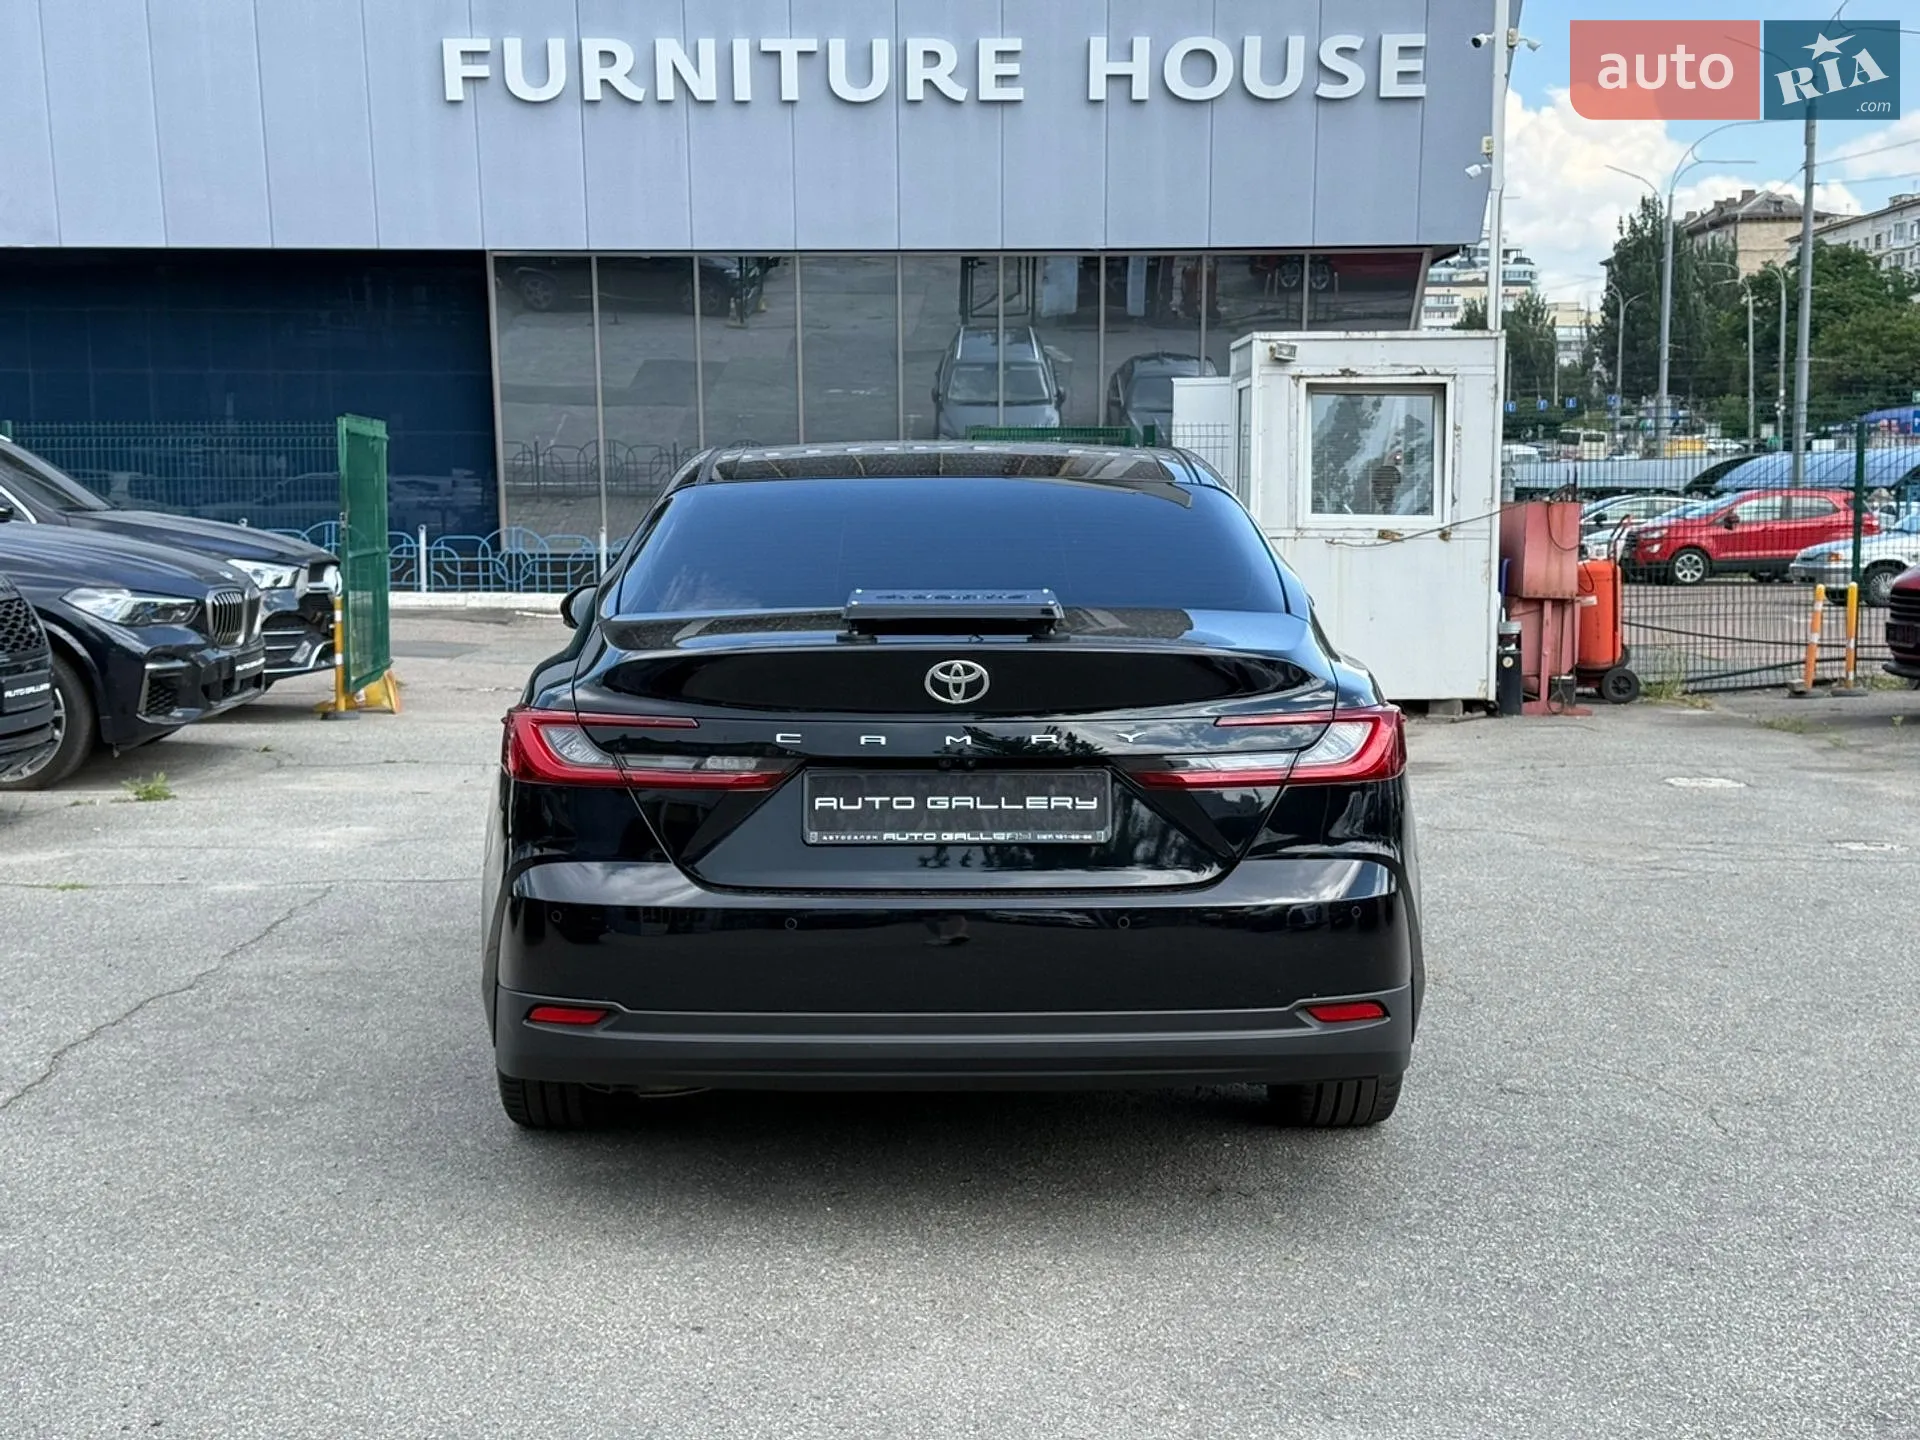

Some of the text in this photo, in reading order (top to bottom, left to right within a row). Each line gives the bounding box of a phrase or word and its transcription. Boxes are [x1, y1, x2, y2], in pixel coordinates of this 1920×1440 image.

[442, 33, 1426, 102] FURNITURE HOUSE
[775, 732, 1148, 746] CAMRY
[814, 796, 1098, 810] AUTO GALLERY
[883, 832, 937, 841] AUTO
